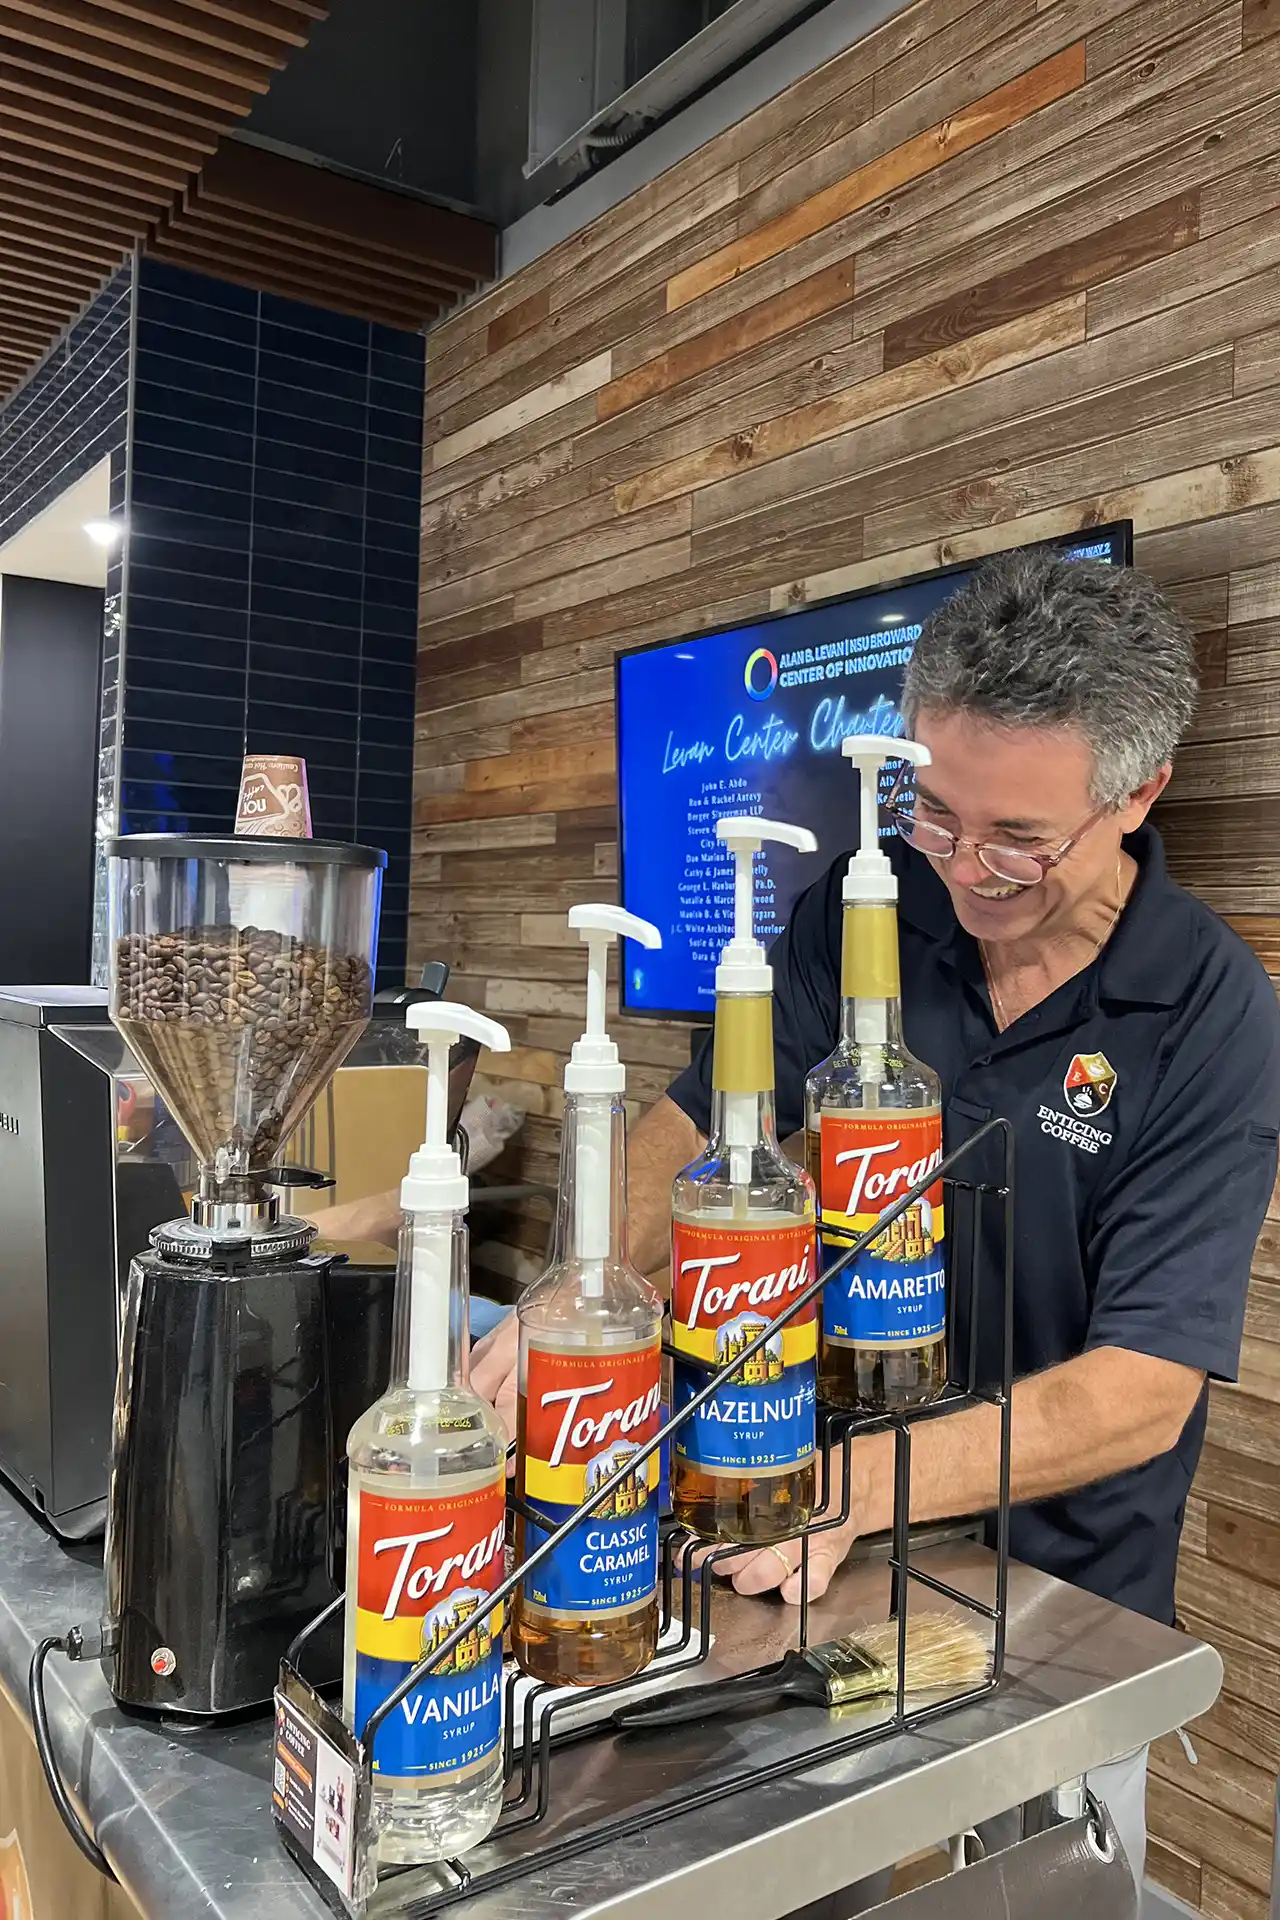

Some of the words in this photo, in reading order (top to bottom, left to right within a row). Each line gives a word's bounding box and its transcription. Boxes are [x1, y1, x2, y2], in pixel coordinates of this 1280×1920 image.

[780, 649, 804, 668] ALAN
[805, 648, 815, 663] B.
[815, 640, 844, 660] LEVAN
[849, 636, 869, 654] NSU
[870, 624, 922, 649] BROWARD
[780, 665, 825, 687] CENTER
[825, 661, 844, 678] OF
[844, 646, 913, 675] INNOVATIO
[662, 731, 714, 774] Levan
[725, 714, 799, 760] Center
[701, 783, 717, 794] John
[688, 798, 702, 807] Ron
[703, 797, 709, 806] &
[711, 794, 736, 805] Rachel
[749, 805, 764, 816] LLP
[687, 826, 710, 836] Steven
[700, 839, 715, 850] City
[713, 867, 734, 878] James
[677, 882, 701, 894] George
[843, 1123, 884, 1131] FORMULA
[886, 1121, 927, 1131] ORIGINALE
[1036, 1104, 1113, 1145] ENTICING
[1041, 1120, 1100, 1154] COFFEE
[687, 1229, 723, 1241] FORMULA
[726, 1234, 776, 1242] ORIGINALE
[681, 1243, 810, 1330] Torani
[847, 1268, 946, 1300] AMARETTO
[897, 1303, 923, 1314] SYRUP
[887, 1328, 910, 1337] SINCE
[912, 1324, 931, 1336] 1925
[550, 1359, 596, 1368] FORMULA
[599, 1356, 645, 1368] ORIGINALE
[541, 1374, 661, 1468] Toran
[733, 1431, 765, 1440] SYRUP
[721, 1455, 747, 1464] SINCE
[750, 1453, 775, 1465] 1925
[384, 1502, 434, 1512] FORMULA
[438, 1493, 489, 1511] ORIGINALE
[586, 1523, 648, 1551] CLASSIC
[579, 1544, 651, 1574] CARAMEL
[604, 1572, 634, 1587] SYRUP
[591, 1595, 617, 1605] SINCE
[620, 1586, 642, 1602] 1925
[400, 1672, 500, 1725] VANILLA
[442, 1721, 476, 1740] SYRUP
[428, 1758, 457, 1771] SINCE
[461, 1743, 484, 1764] 1925
